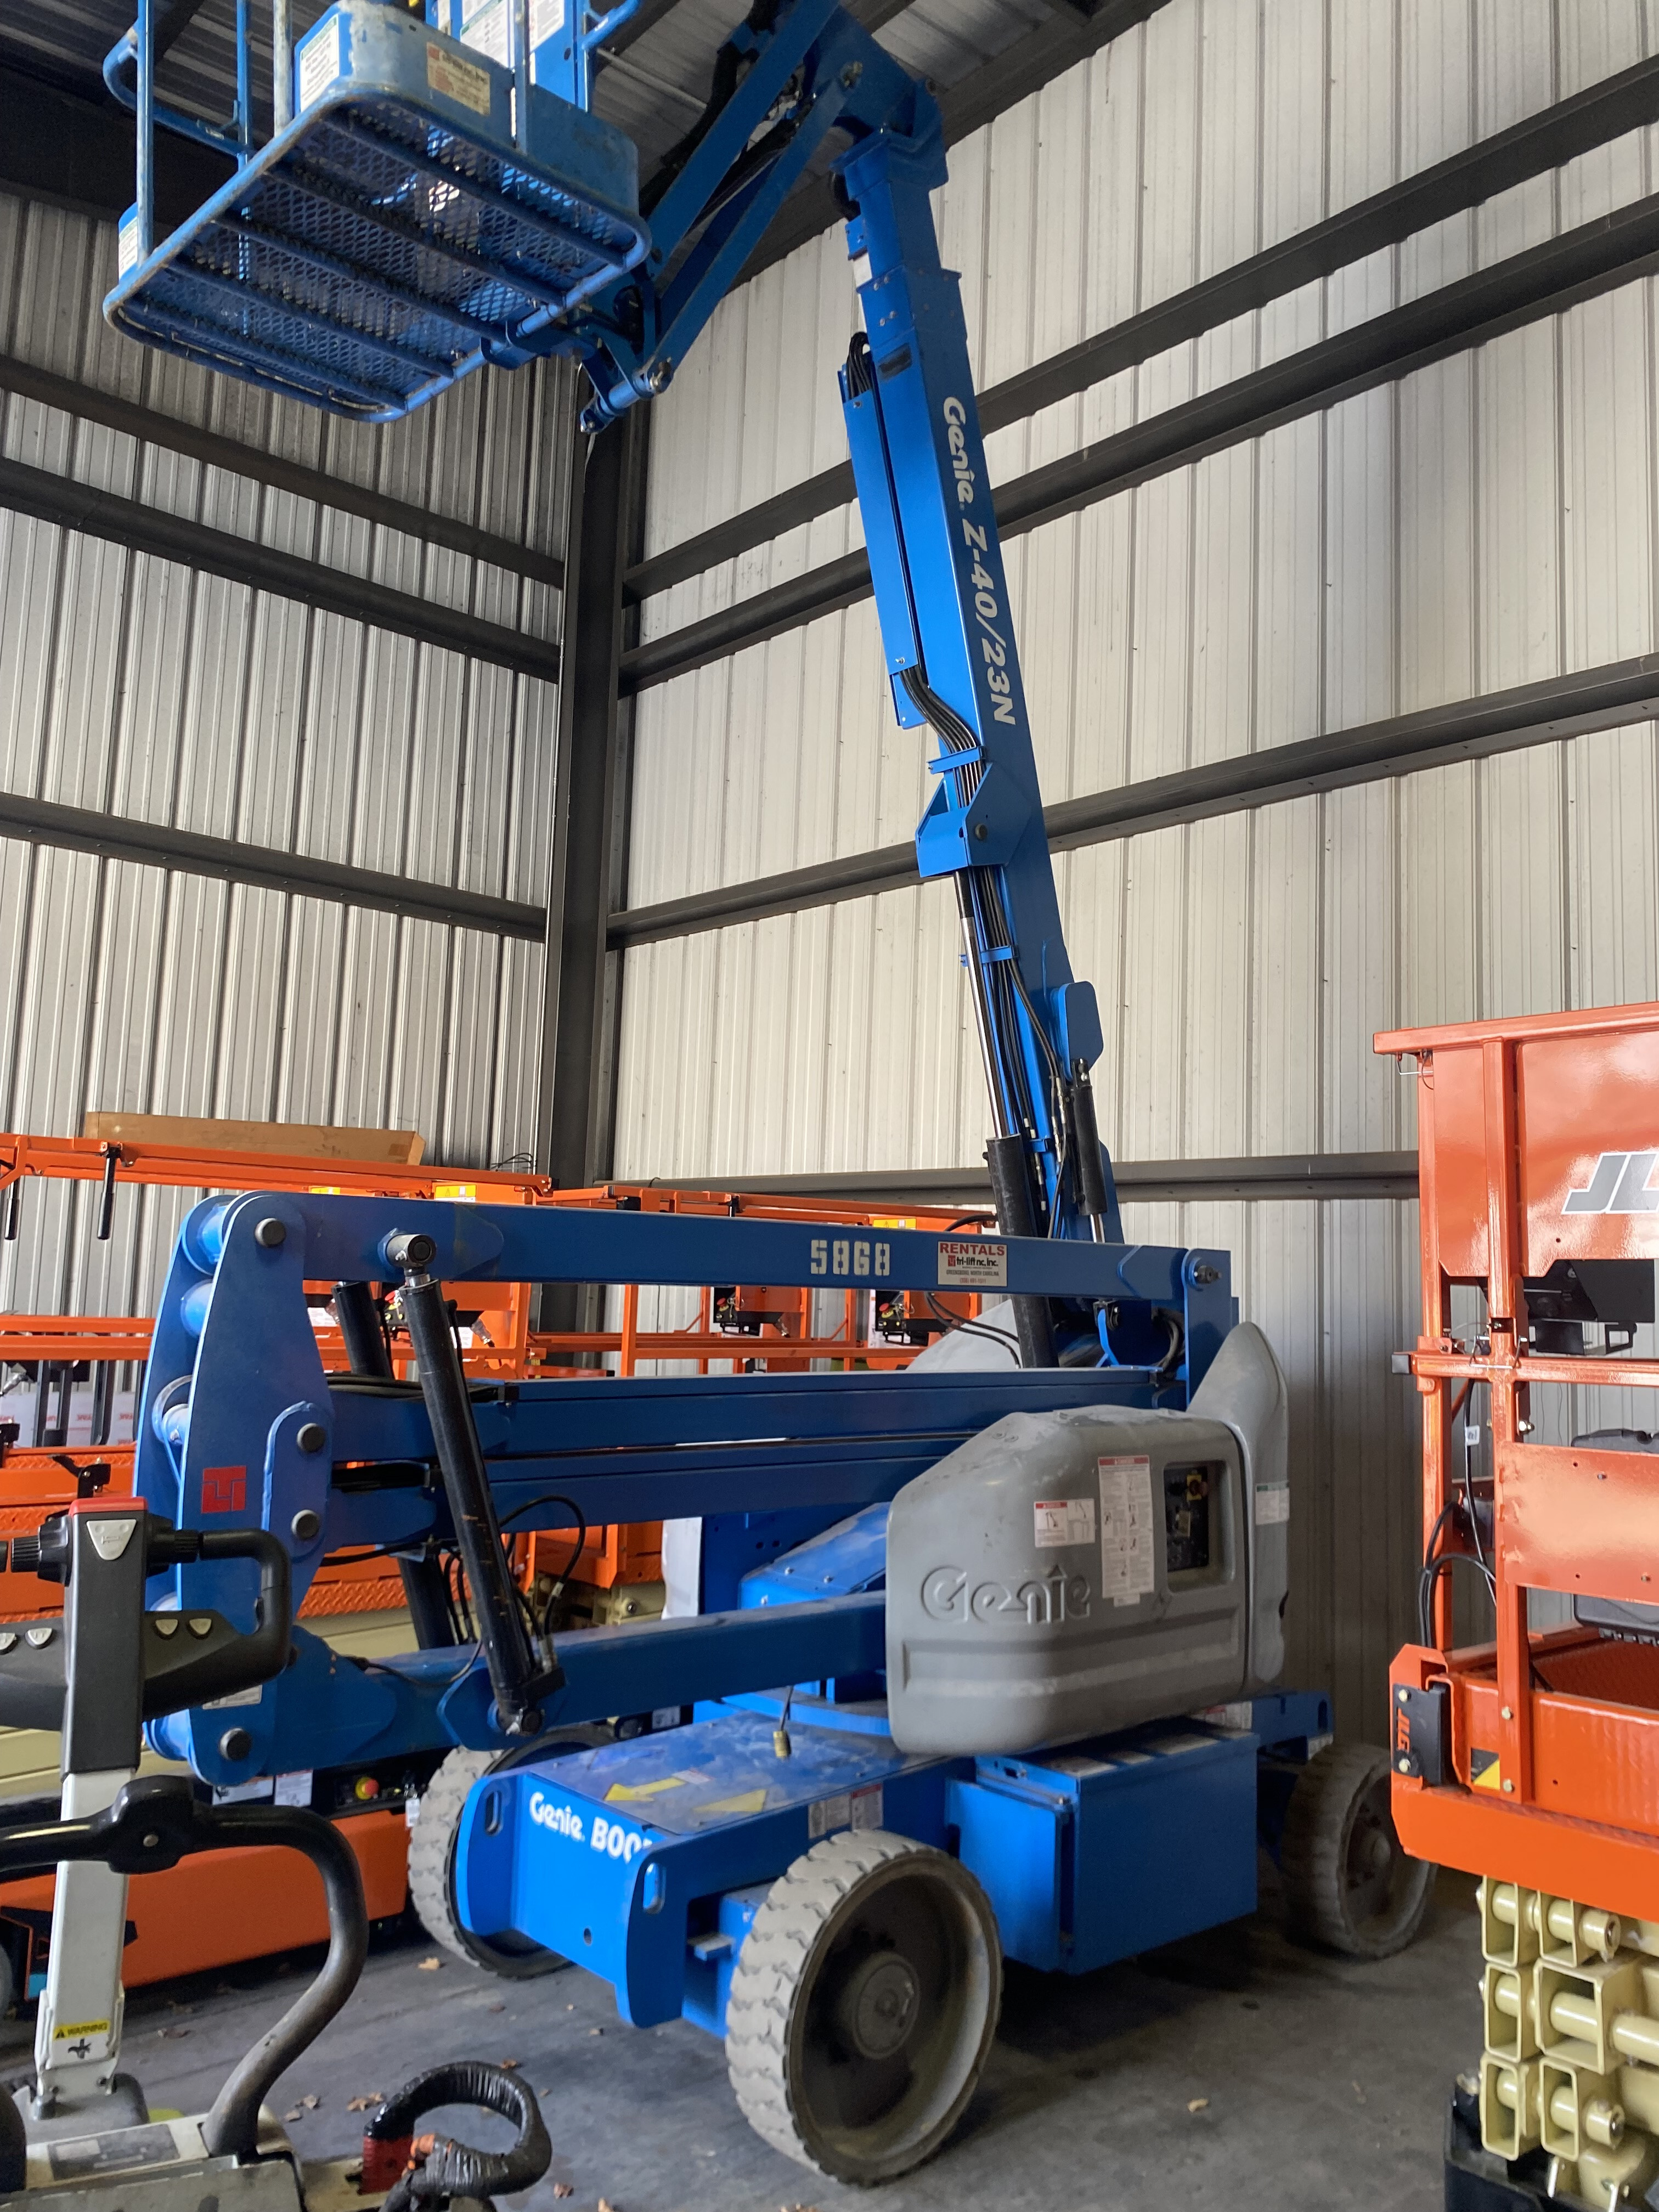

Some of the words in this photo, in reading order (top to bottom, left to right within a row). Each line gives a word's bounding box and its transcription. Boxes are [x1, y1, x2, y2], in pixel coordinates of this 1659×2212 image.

[943, 396, 974, 504] Genie
[962, 518, 1016, 725] Z-40/23N
[811, 1240, 890, 1276] 5868
[940, 1243, 1005, 1256] RENTALS
[956, 1256, 975, 1266] tri-lift
[921, 1564, 1091, 1625] Genie
[1397, 1707, 1410, 1754] JLG
[529, 1791, 583, 1842] Genie
[590, 1816, 653, 1864] BOO
